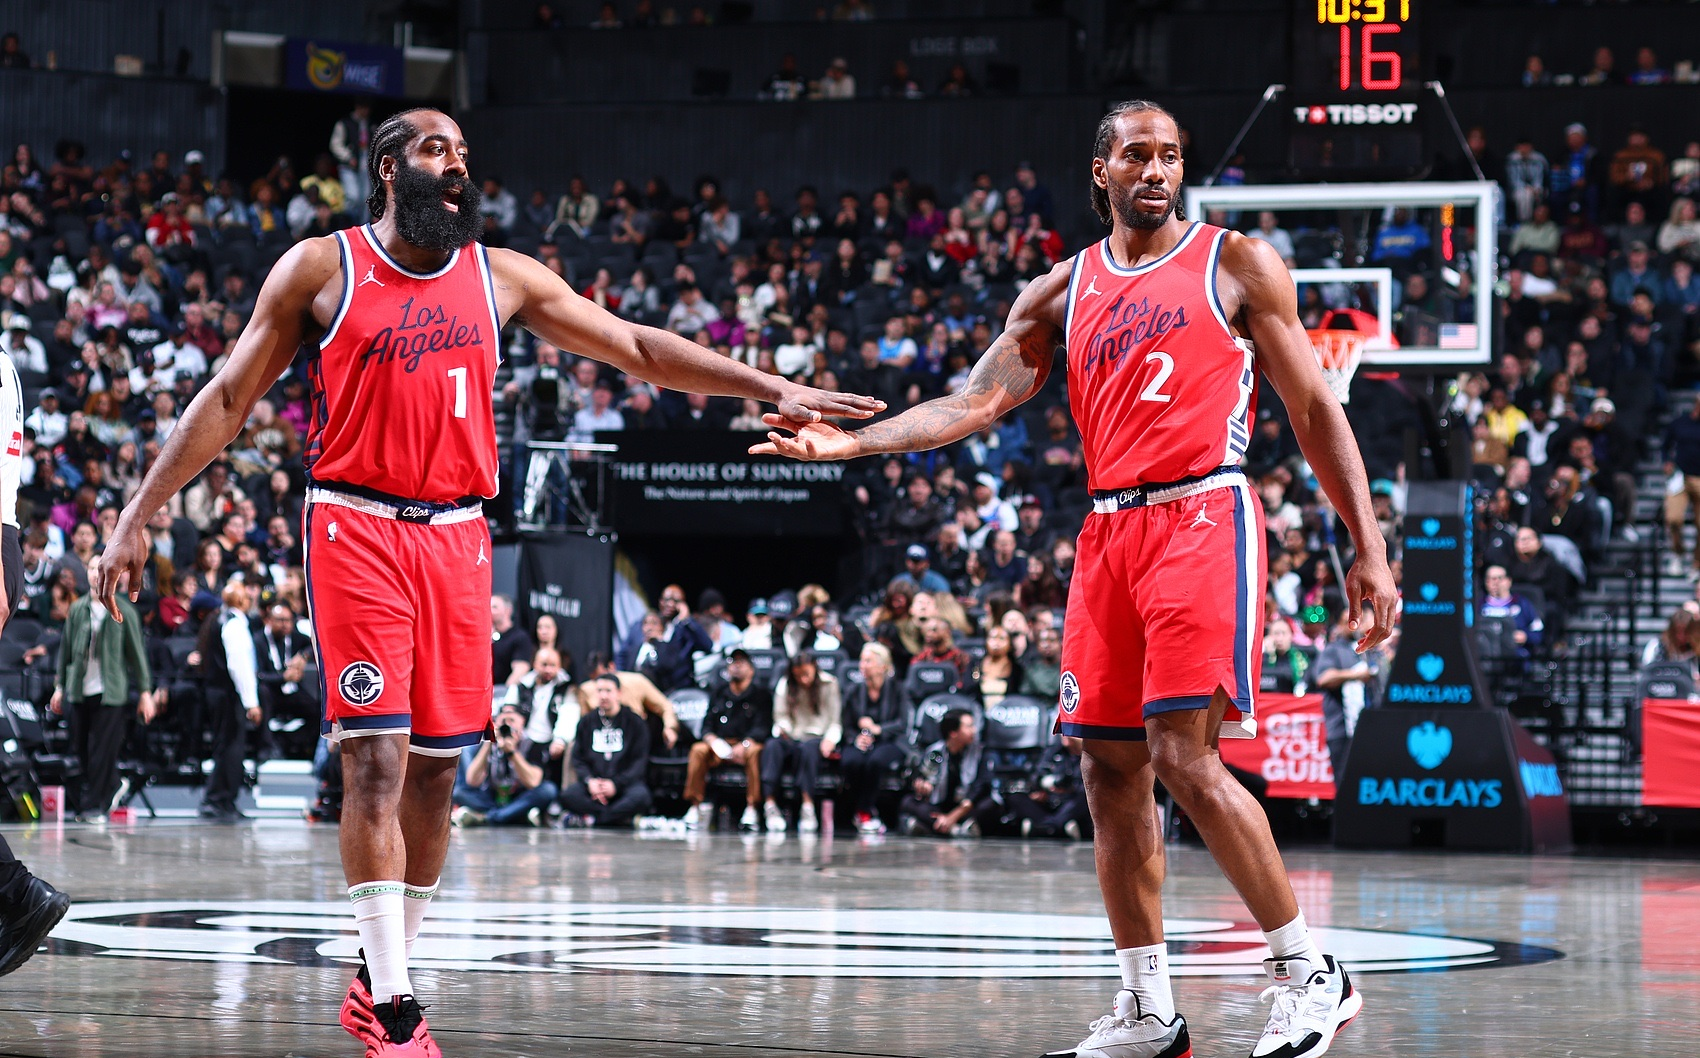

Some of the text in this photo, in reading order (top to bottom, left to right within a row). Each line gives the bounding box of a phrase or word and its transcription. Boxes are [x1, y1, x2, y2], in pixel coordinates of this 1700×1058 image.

[1340, 23, 1401, 90] 16
[1327, 103, 1418, 124] TISSOT
[398, 296, 448, 331] Los
[1106, 296, 1152, 334] Los
[360, 315, 483, 374] Angeles
[1084, 303, 1190, 380] Angeles
[447, 366, 467, 419] 1
[1140, 351, 1175, 403] 2
[610, 462, 846, 482] THE HOUSE OF SUNTORY
[1119, 487, 1142, 505] Clips
[1388, 683, 1473, 704] BARCLAYS
[1264, 713, 1326, 737] GET
[1358, 776, 1503, 808] BARCLAYS
